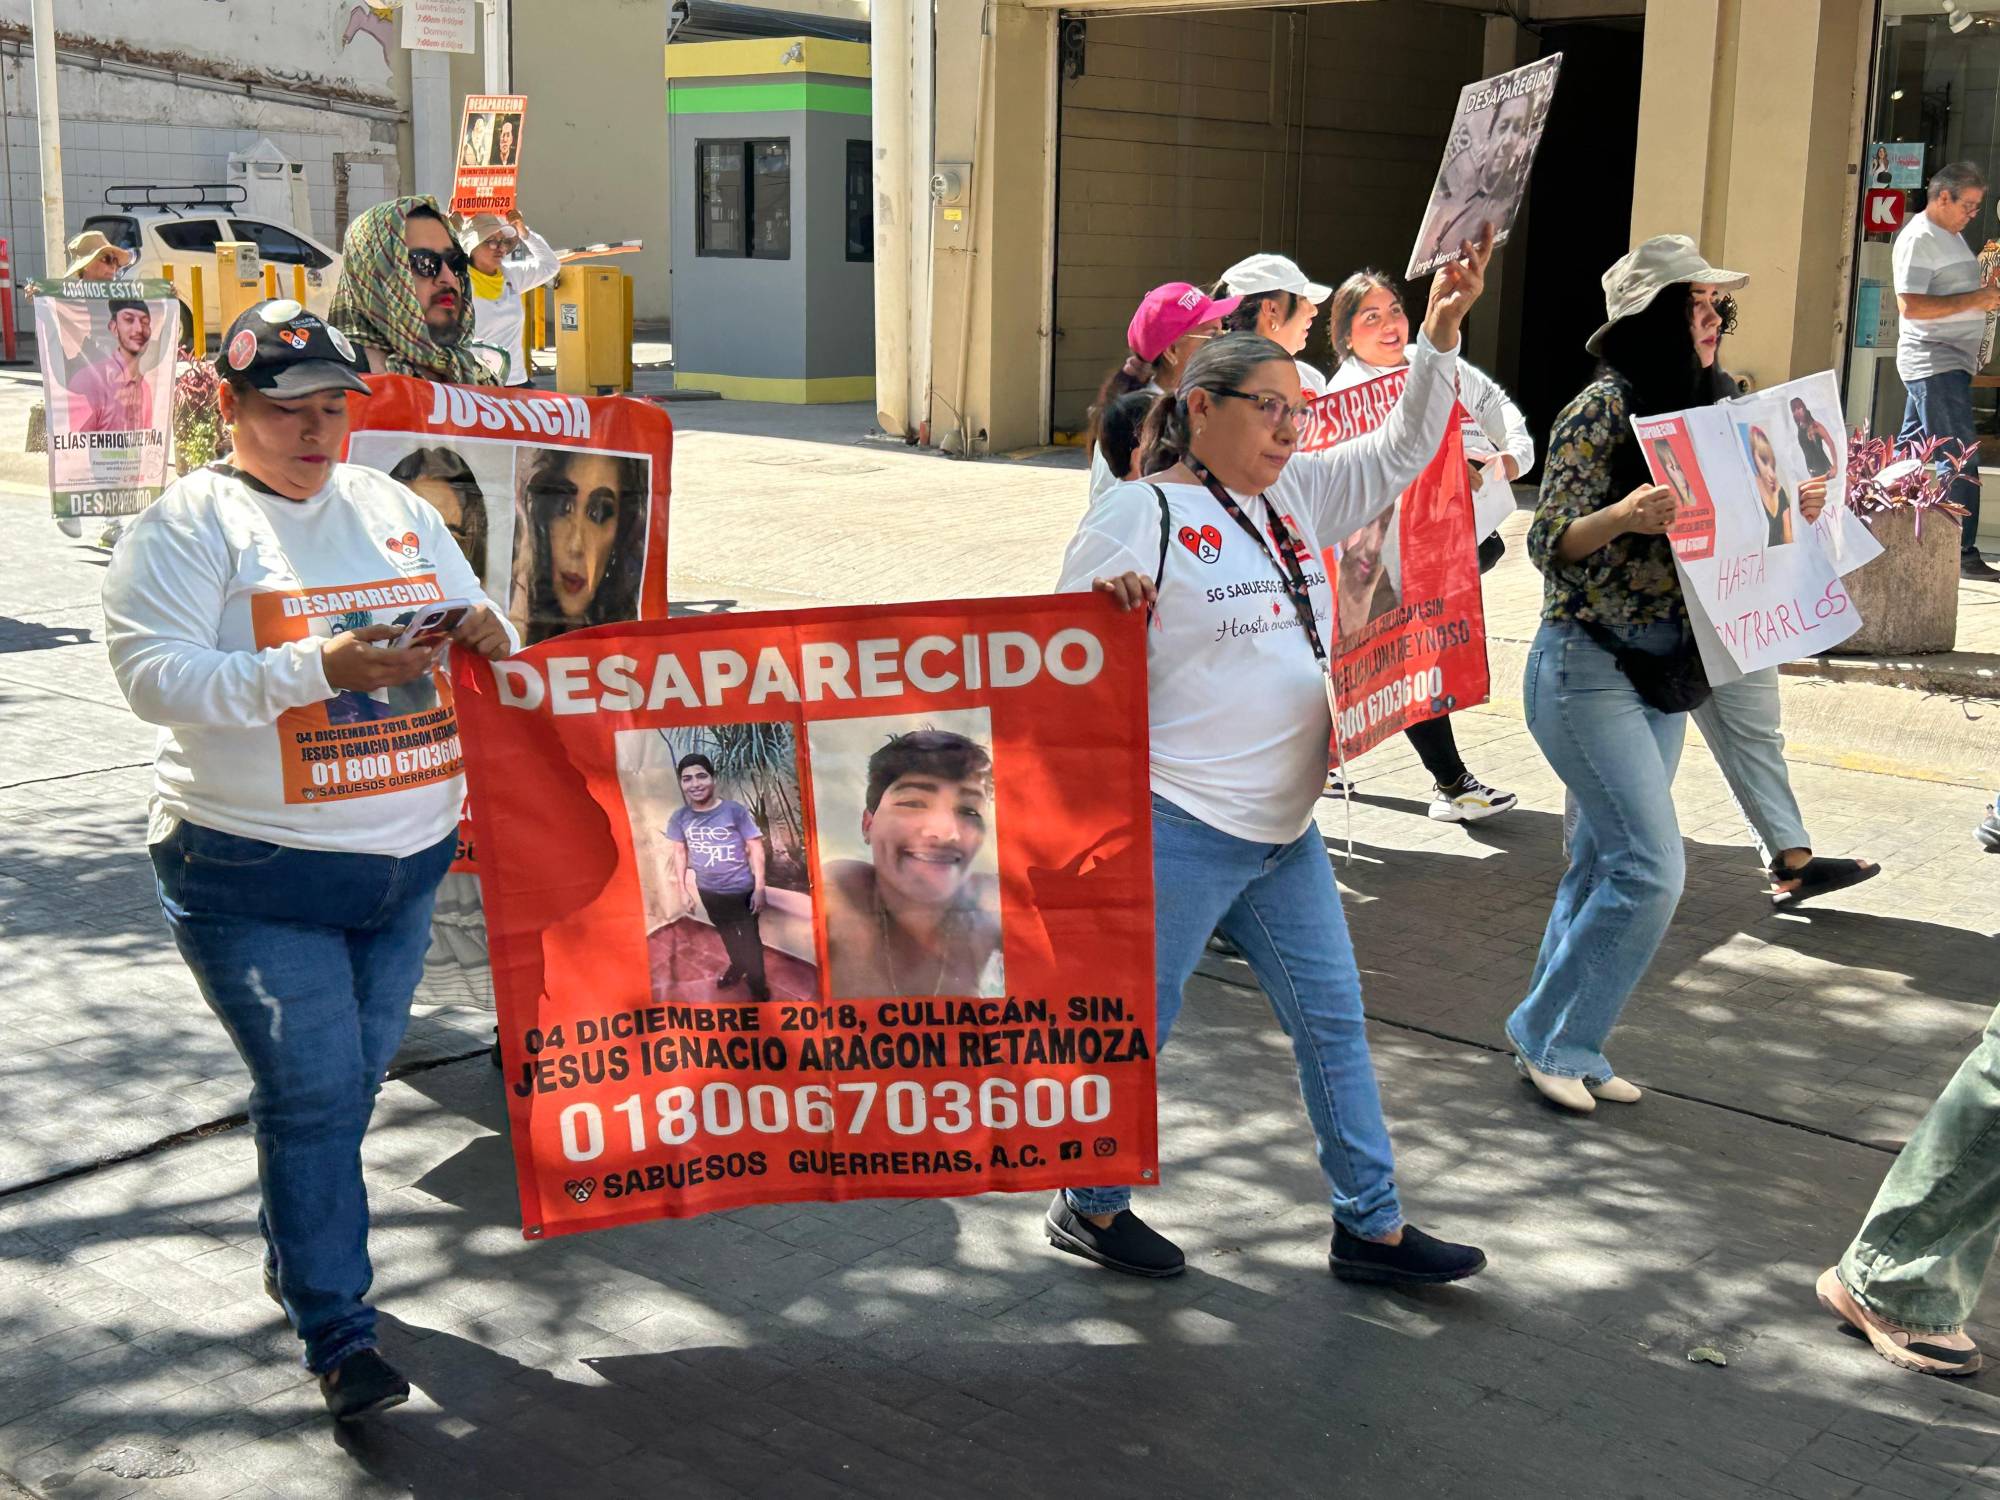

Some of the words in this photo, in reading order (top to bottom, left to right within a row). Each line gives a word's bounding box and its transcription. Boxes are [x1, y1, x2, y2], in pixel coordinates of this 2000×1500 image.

[468, 98, 524, 111] DESAPARECIDO
[1464, 65, 1554, 115] DESAPARECIDO
[1871, 196, 1897, 225] K
[428, 381, 591, 439] JUSTICIA
[54, 431, 87, 450] ELÍAS
[144, 429, 163, 447] PIÑA
[1206, 587, 1225, 603] SG
[1227, 578, 1278, 599] SABUESOS
[1717, 546, 1766, 600] HASTA
[282, 583, 442, 617] DESAPARECIDO
[1215, 615, 1270, 642] Hasta
[1397, 619, 1470, 663] REYNOSO
[496, 628, 1105, 715] DESAPARECIDO
[1367, 666, 1443, 726] 6703600
[302, 745, 339, 762] JESUS
[341, 738, 389, 758] IGNACIO
[392, 730, 433, 751] ARAGON
[315, 723, 381, 742] DICIEMBRE
[312, 762, 341, 786] 01
[346, 754, 392, 782] 800
[319, 780, 386, 797] SABUESOS
[525, 1025, 566, 1054] 04
[576, 1006, 761, 1045] DICIEMBRE
[780, 1004, 867, 1032] 2018,
[878, 996, 1057, 1027] CULIACÁN,
[1067, 997, 1134, 1022] SIN.
[512, 1046, 630, 1098] JESUS
[641, 1036, 788, 1076] IGNACIO
[798, 1031, 946, 1072] ARAGON
[958, 1027, 1149, 1068] RETAMOZA
[559, 1074, 1111, 1163] 018006703600
[602, 1151, 768, 1198] SABUESOS
[788, 1149, 982, 1177] GUERRERAS,
[989, 1144, 1047, 1171] A.C.
